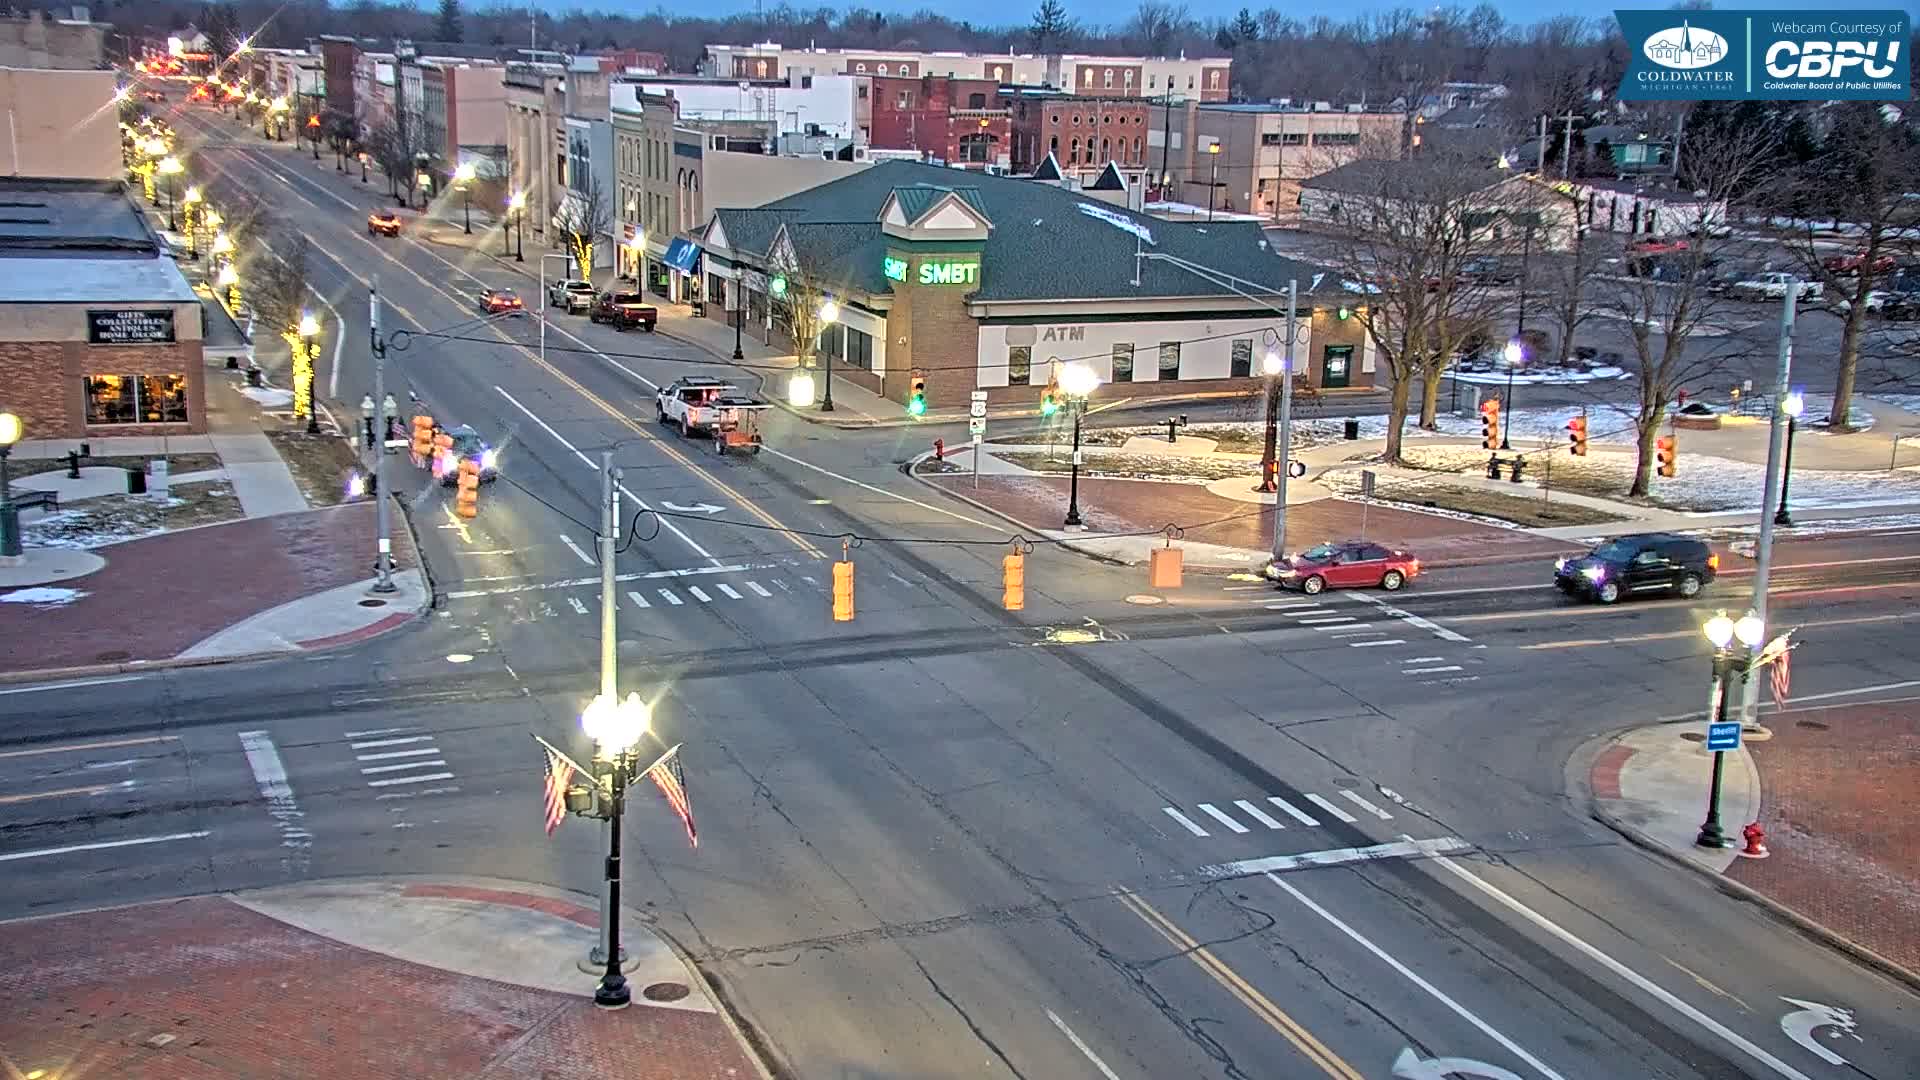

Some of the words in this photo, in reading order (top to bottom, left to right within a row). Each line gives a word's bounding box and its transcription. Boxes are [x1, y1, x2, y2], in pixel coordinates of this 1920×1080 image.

[884, 257, 907, 282] SMBT
[920, 263, 977, 284] SMBT
[1043, 326, 1085, 341] ATM
